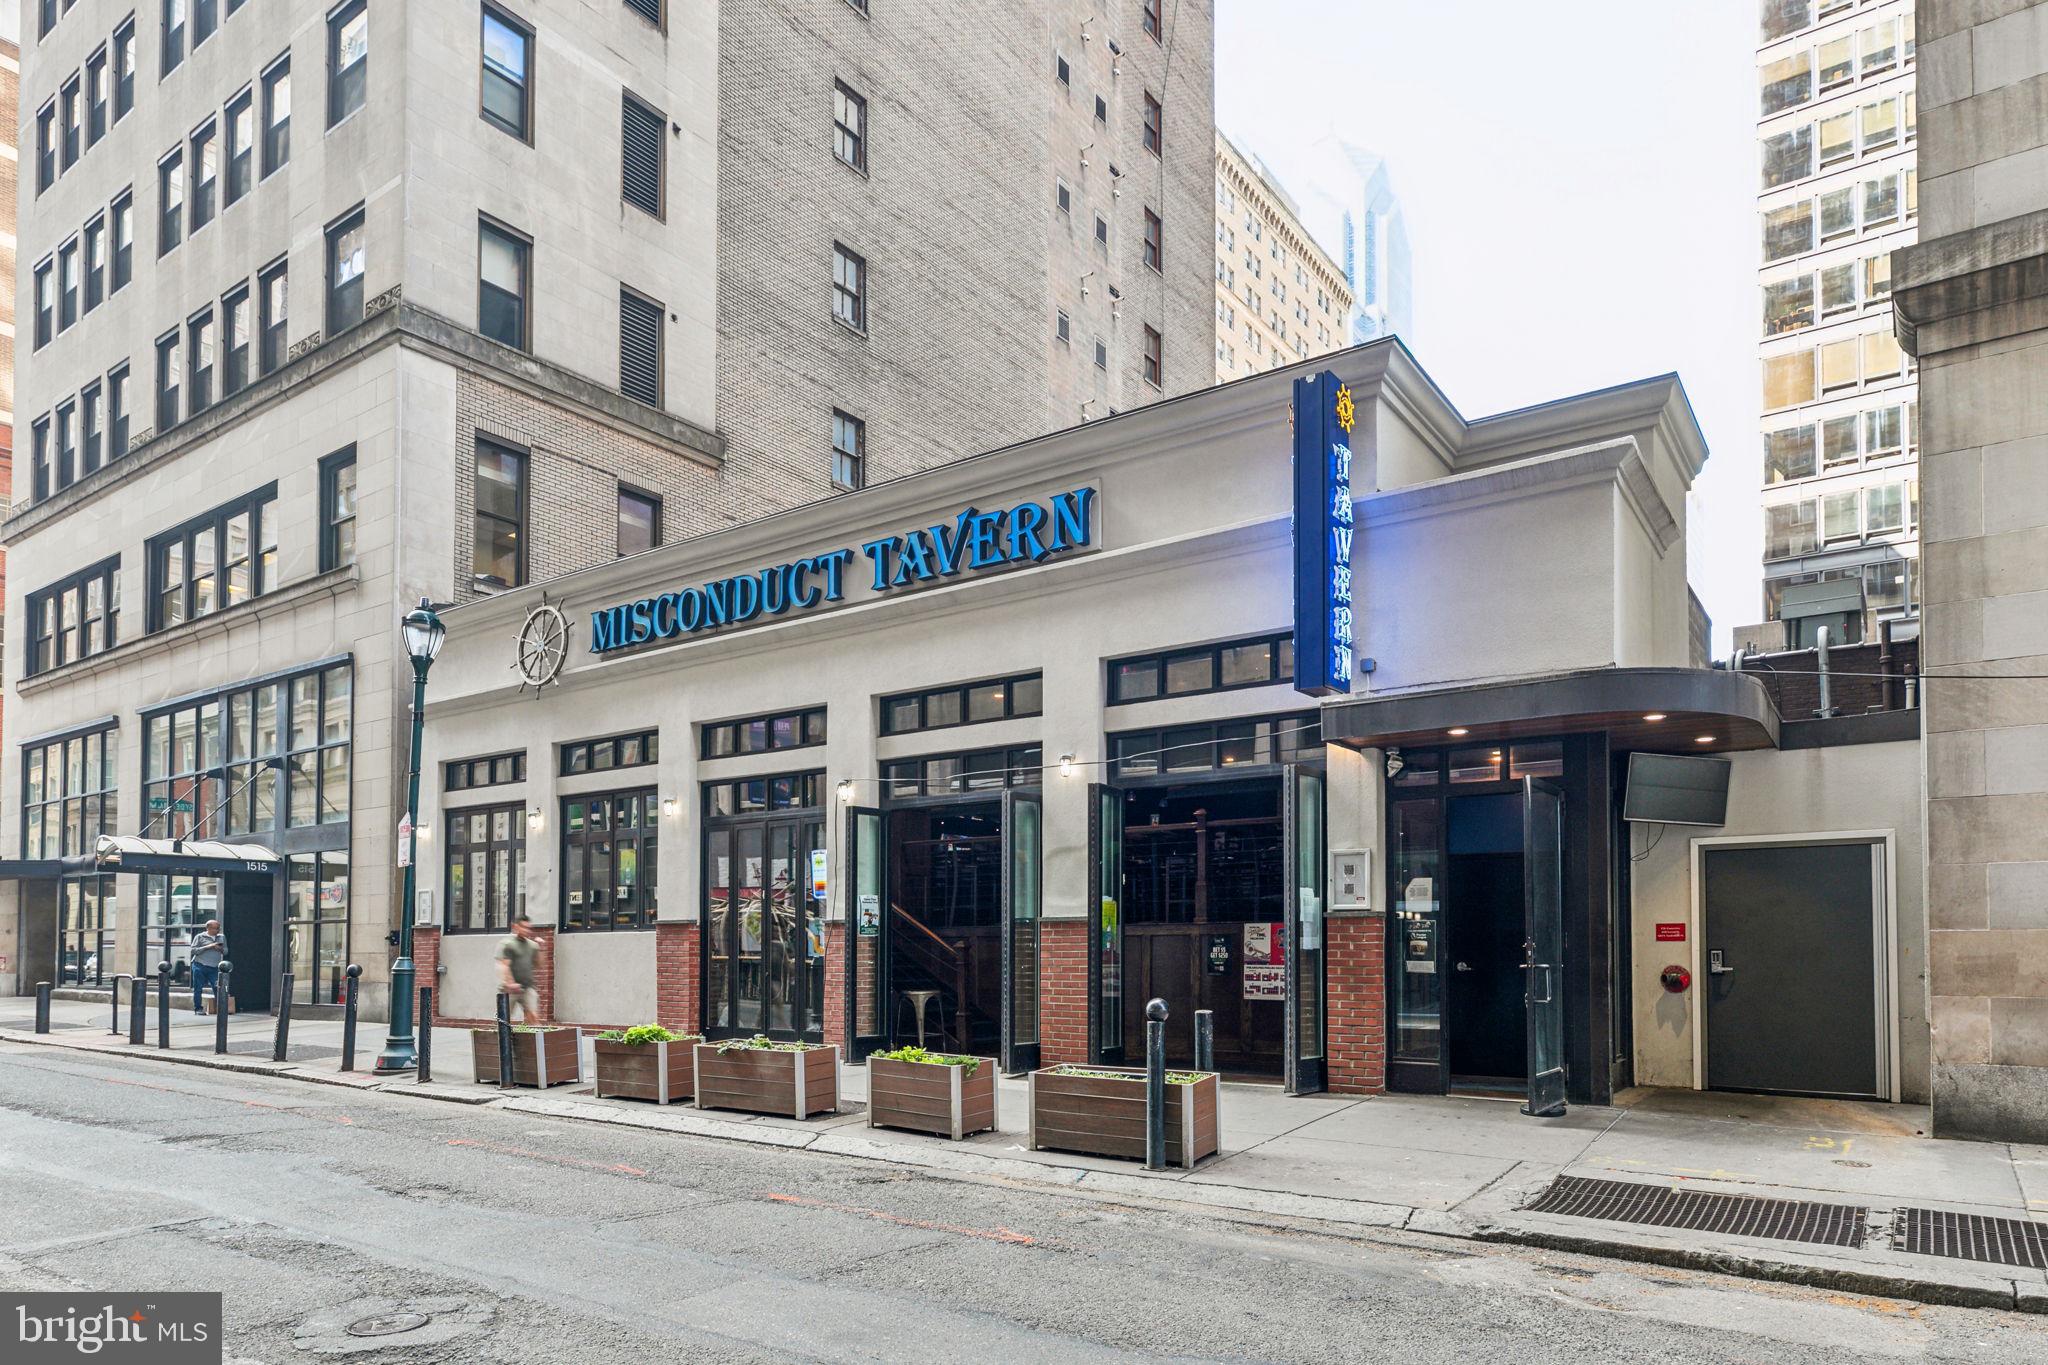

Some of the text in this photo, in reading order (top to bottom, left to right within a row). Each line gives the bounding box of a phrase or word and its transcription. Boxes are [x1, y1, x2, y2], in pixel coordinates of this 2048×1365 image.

[589, 487, 1096, 654] MISCONDUCT TAVERN
[1332, 443, 1353, 682] TAVERN
[246, 861, 268, 871] 1515
